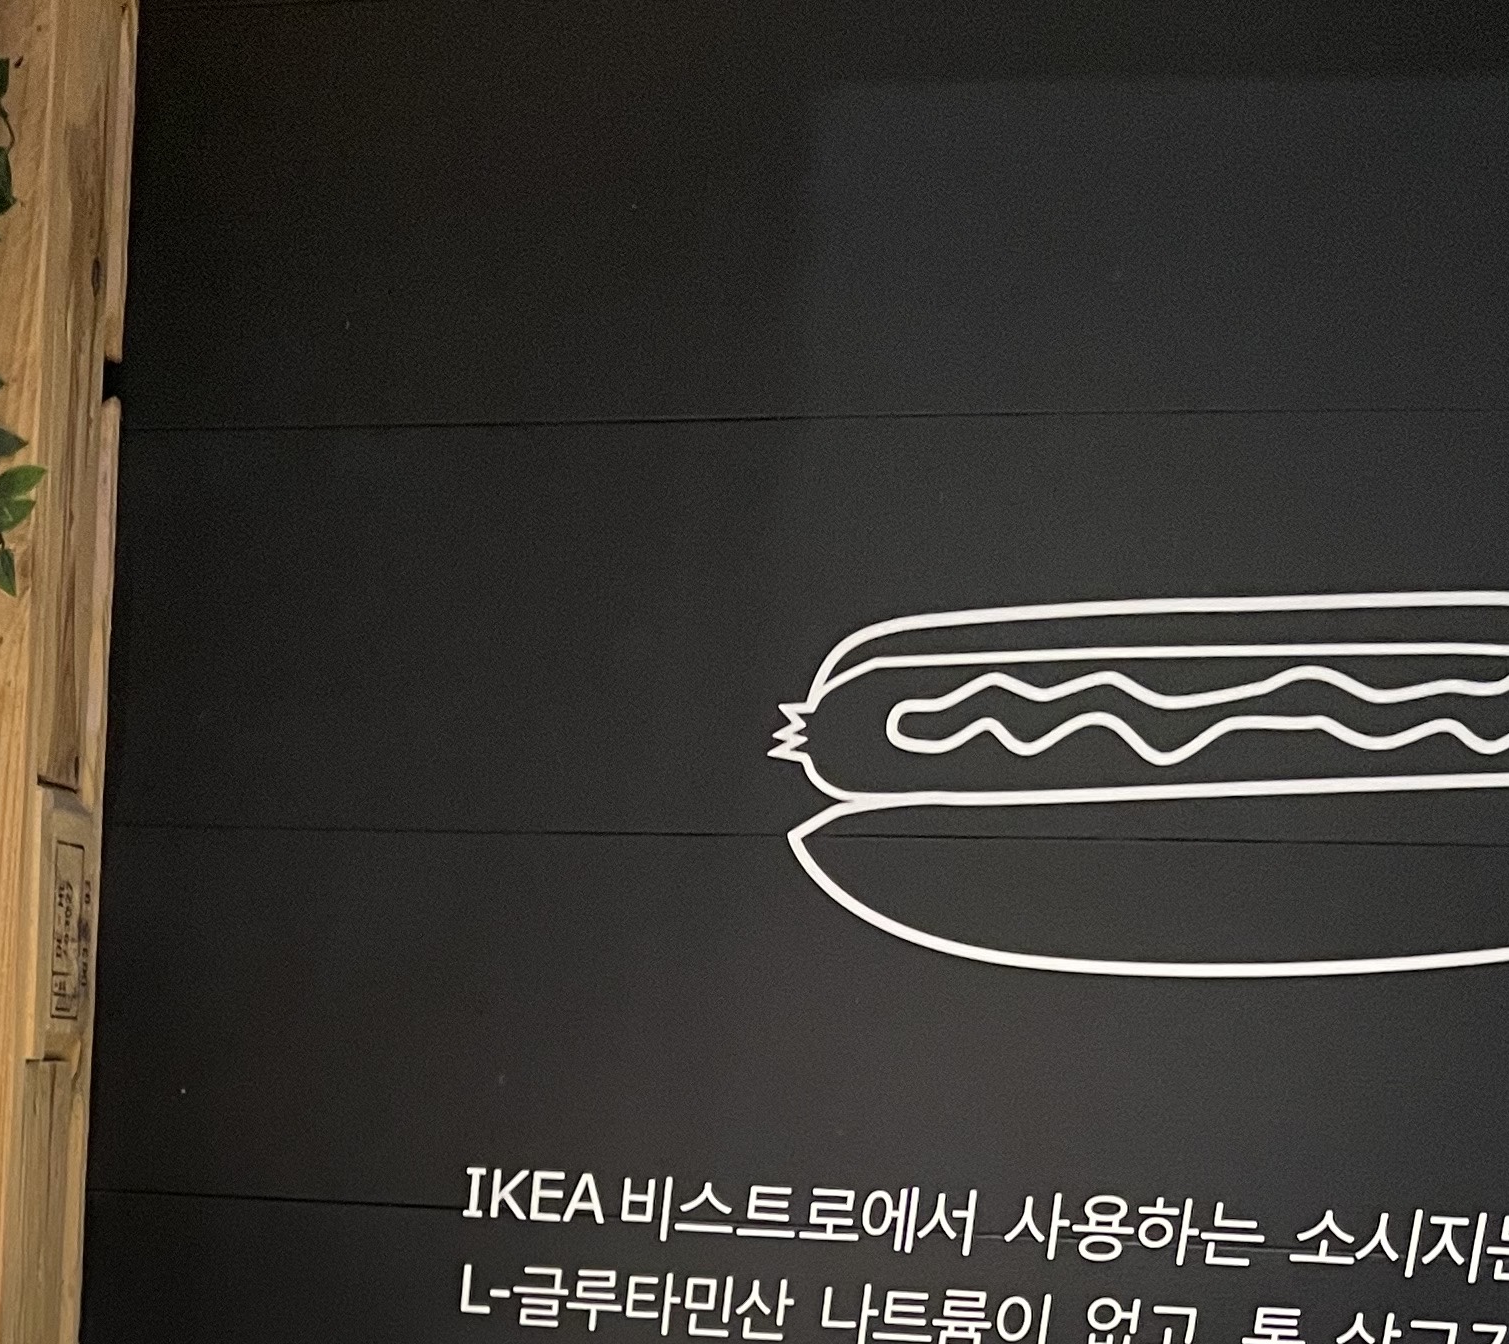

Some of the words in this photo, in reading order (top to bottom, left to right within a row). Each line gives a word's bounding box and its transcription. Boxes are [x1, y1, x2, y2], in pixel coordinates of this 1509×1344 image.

[462, 1166, 605, 1225] IKEA
[620, 1175, 978, 1257] 비스트로에서
[1003, 1192, 1266, 1267] 사용하는
[1289, 1208, 1509, 1284] 소시지
[460, 1263, 795, 1341] L-글루타민산
